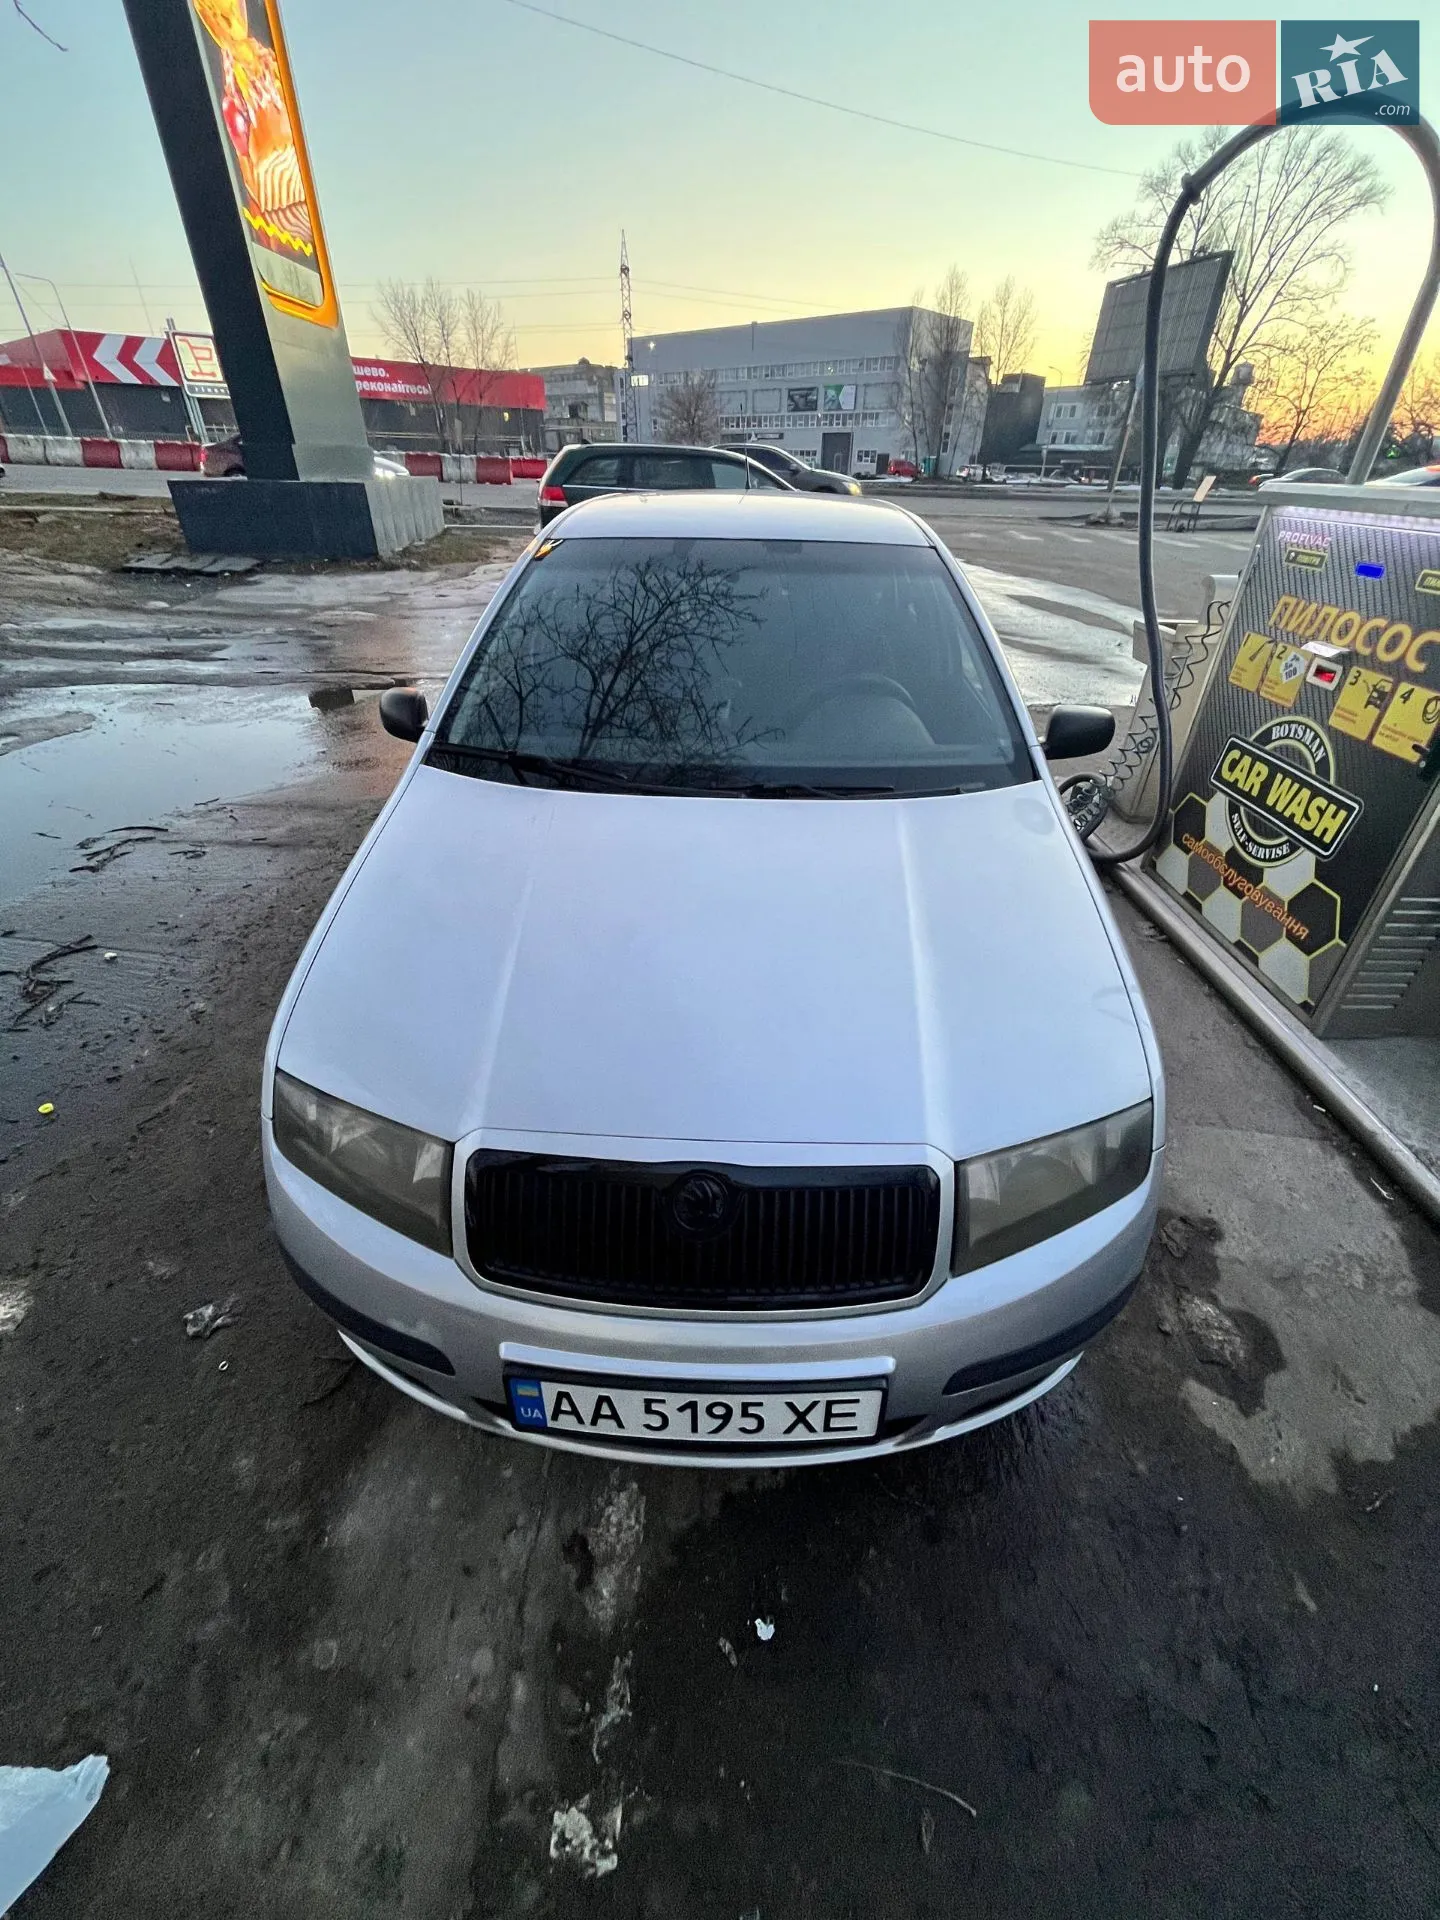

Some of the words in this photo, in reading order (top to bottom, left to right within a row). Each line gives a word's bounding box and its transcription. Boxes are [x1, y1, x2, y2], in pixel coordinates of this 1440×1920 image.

[1278, 530, 1332, 547] PROFIVAC
[1268, 594, 1440, 673] ПИЛОСОС
[1276, 645, 1288, 660] 2
[1348, 670, 1362, 686] 3
[1400, 687, 1415, 704] 4
[1271, 723, 1326, 764] BOTSMAN
[1221, 749, 1269, 797] CAR
[1266, 772, 1348, 844] WASH
[1231, 813, 1291, 860] SELF-SERVISE
[1182, 833, 1310, 940] самообслуговування
[520, 1406, 543, 1420] UA
[550, 1390, 626, 1430] AA
[642, 1397, 766, 1435] 5195
[782, 1398, 861, 1435] XE
